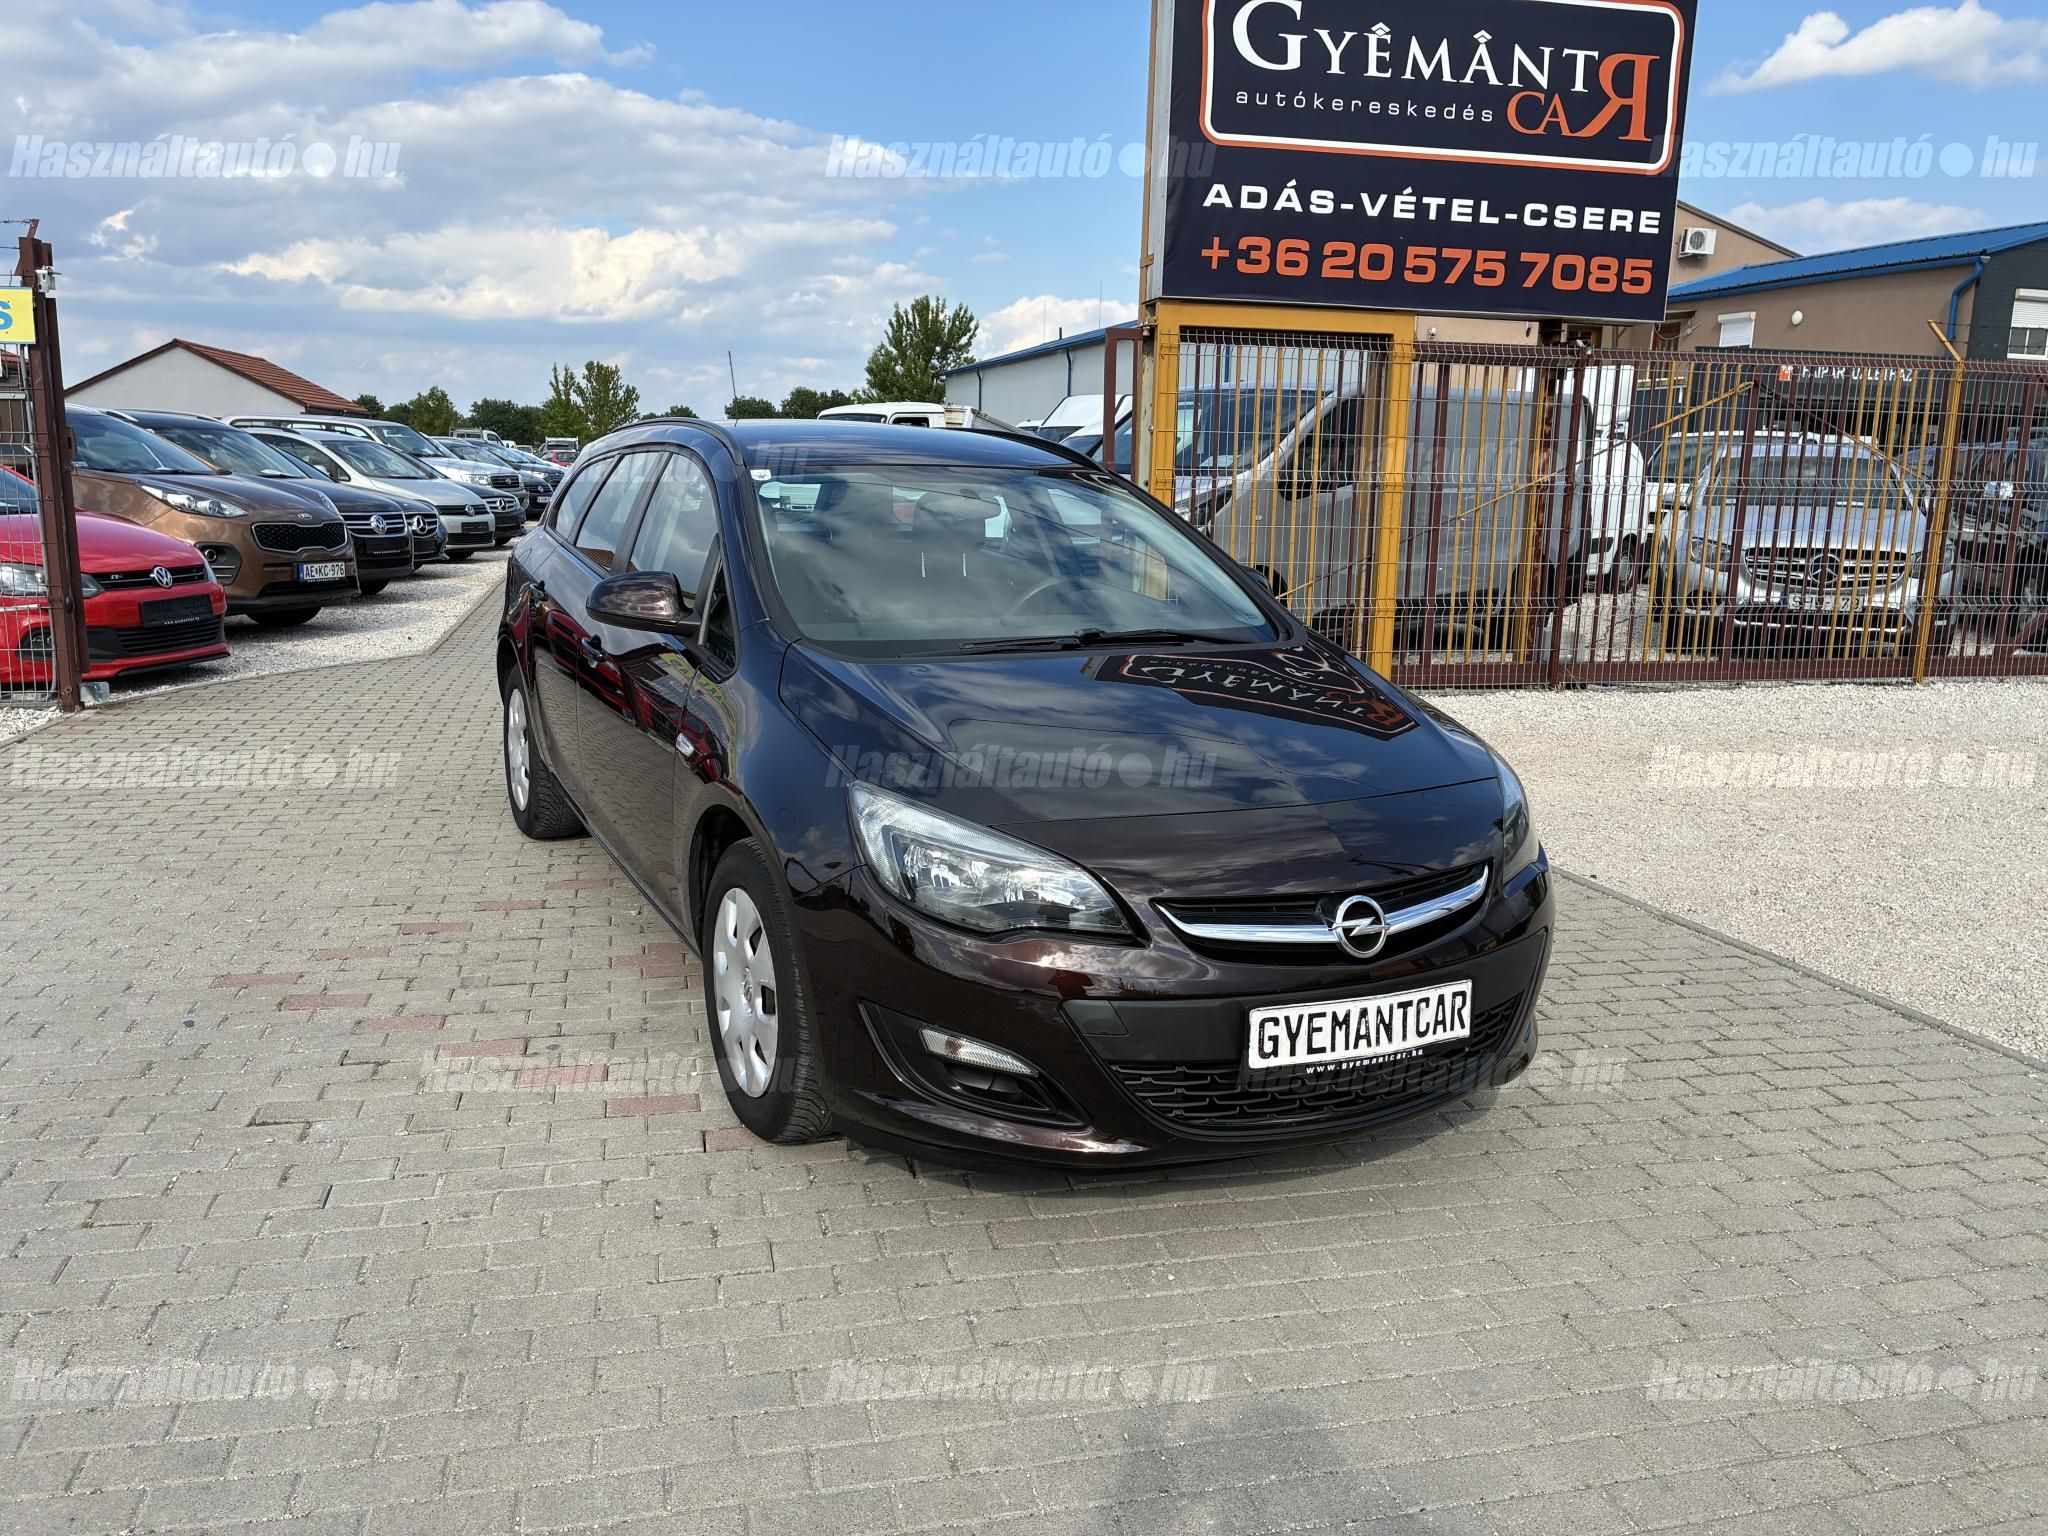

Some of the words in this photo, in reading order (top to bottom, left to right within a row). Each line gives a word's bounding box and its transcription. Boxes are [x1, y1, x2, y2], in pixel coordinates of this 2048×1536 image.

[1235, 90, 1494, 122] autókereskedés
[1202, 178, 1661, 235] ADÁS-VÉTEL-CSERE
[1201, 236, 1310, 277] +36
[1321, 241, 1394, 281] 20
[1403, 245, 1507, 288] 575
[1519, 250, 1653, 295] 7085
[1258, 990, 1468, 1060] GYEMANTCAR
[1306, 1048, 1424, 1074] www.gyemantcar.hu
